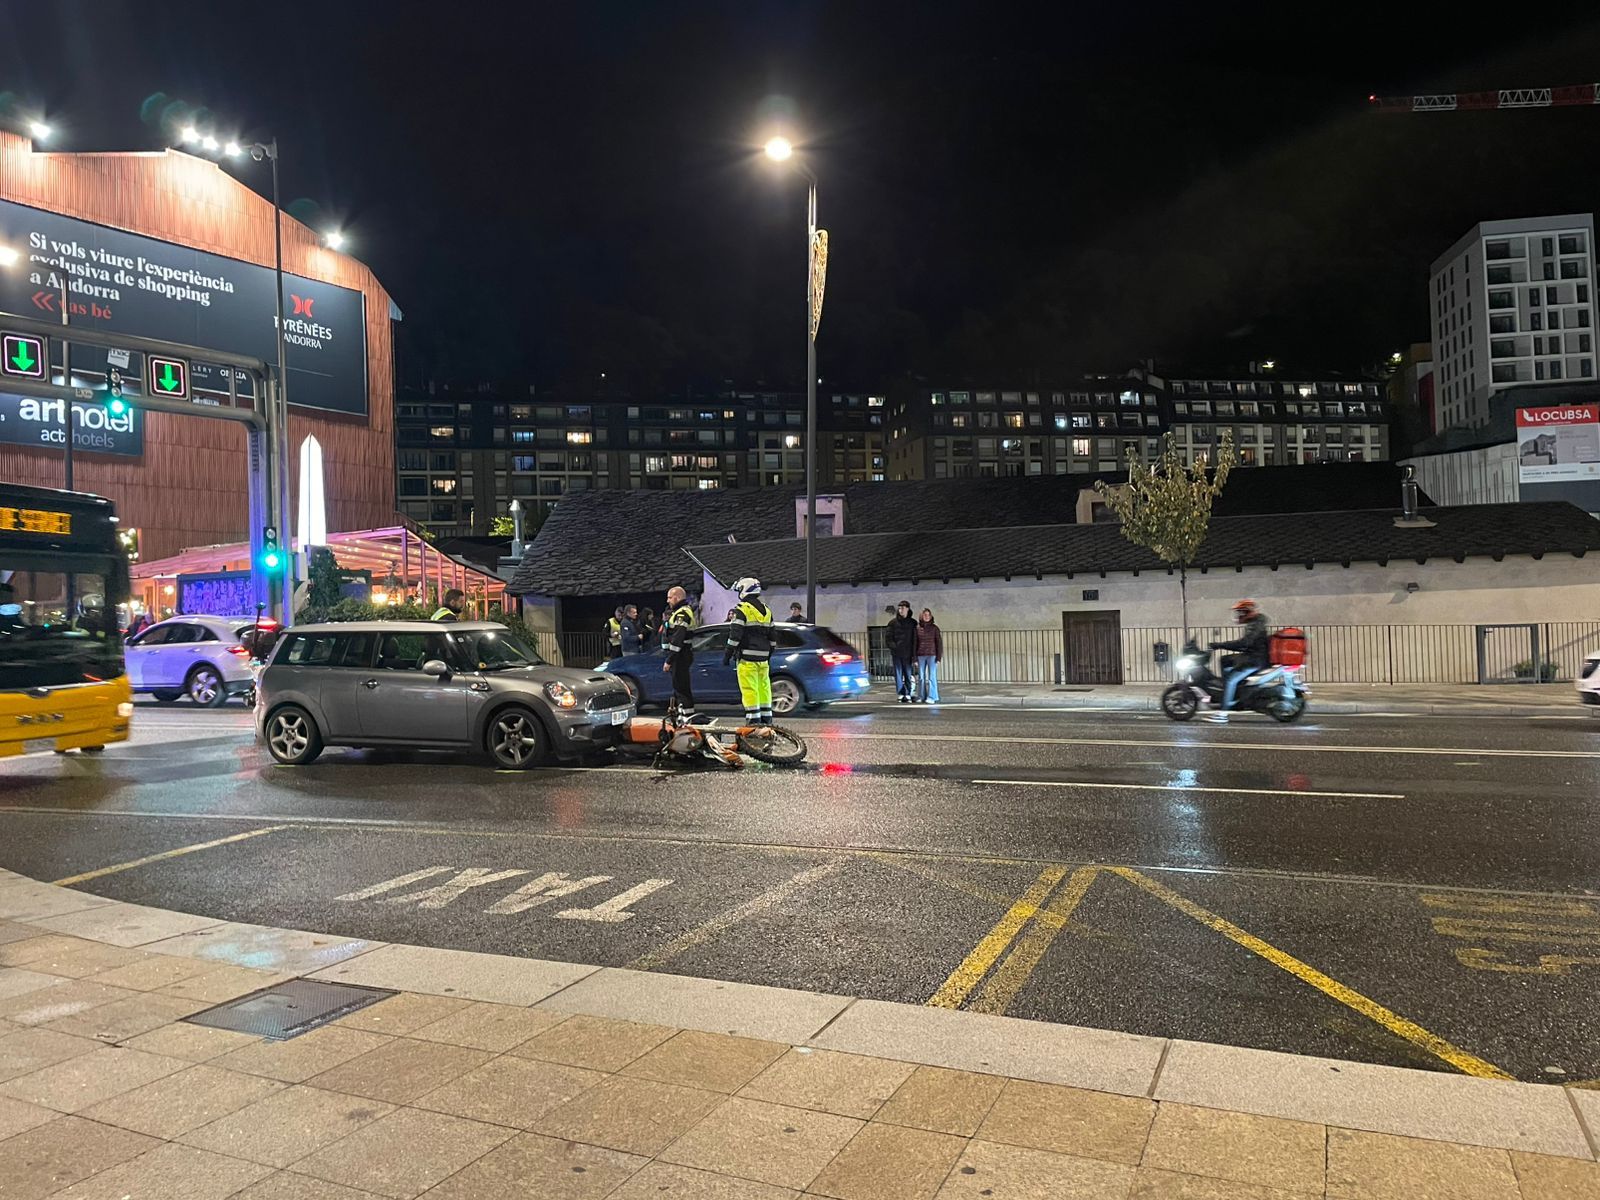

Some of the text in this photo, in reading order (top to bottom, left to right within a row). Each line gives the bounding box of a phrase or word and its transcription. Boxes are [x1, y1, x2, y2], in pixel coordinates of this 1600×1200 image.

[30, 231, 234, 293] Si vols viure l'experiència
[30, 272, 41, 284] a
[114, 269, 135, 286] de
[138, 276, 211, 306] shopping
[283, 332, 322, 350] ANDORRA
[1534, 409, 1591, 422] LOCUBSA
